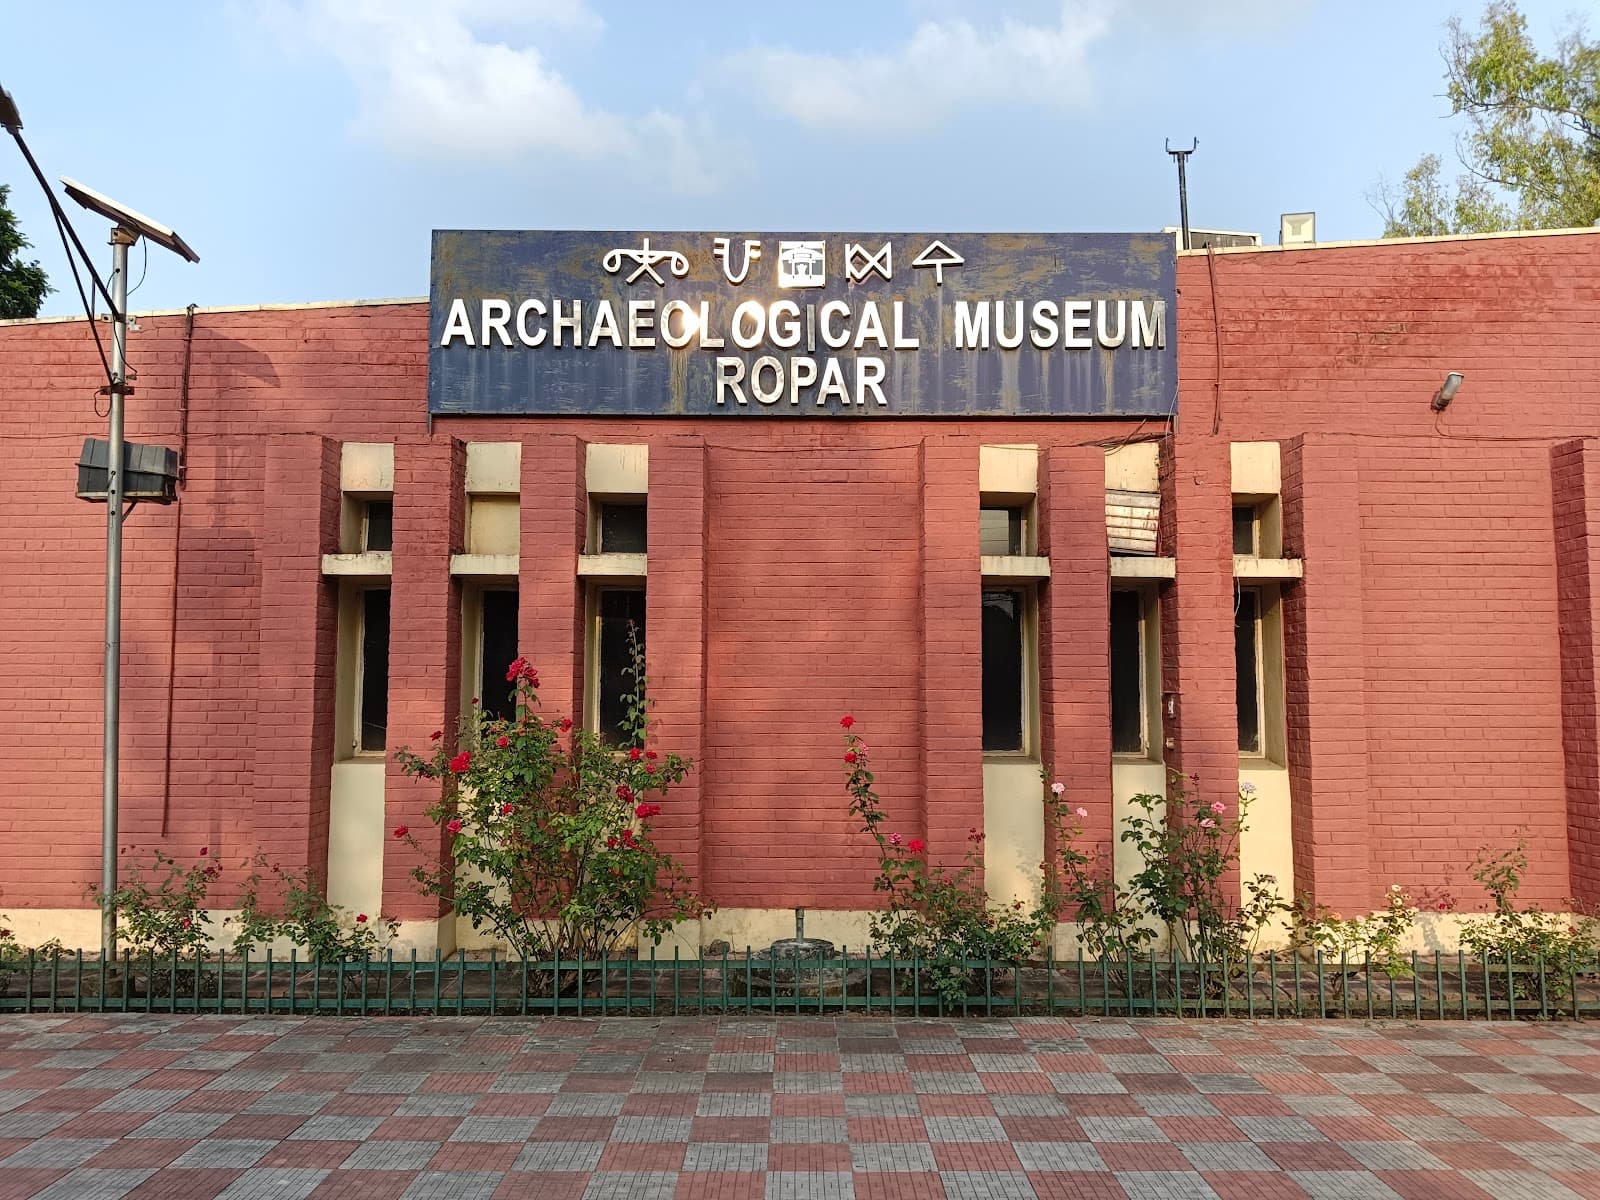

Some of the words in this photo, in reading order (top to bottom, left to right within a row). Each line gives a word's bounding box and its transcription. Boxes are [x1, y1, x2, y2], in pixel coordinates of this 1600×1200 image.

[440, 298, 920, 350] ARCHAEOLOGICAL
[954, 299, 1167, 350] MUSEUM
[715, 355, 888, 407] ROPAR
